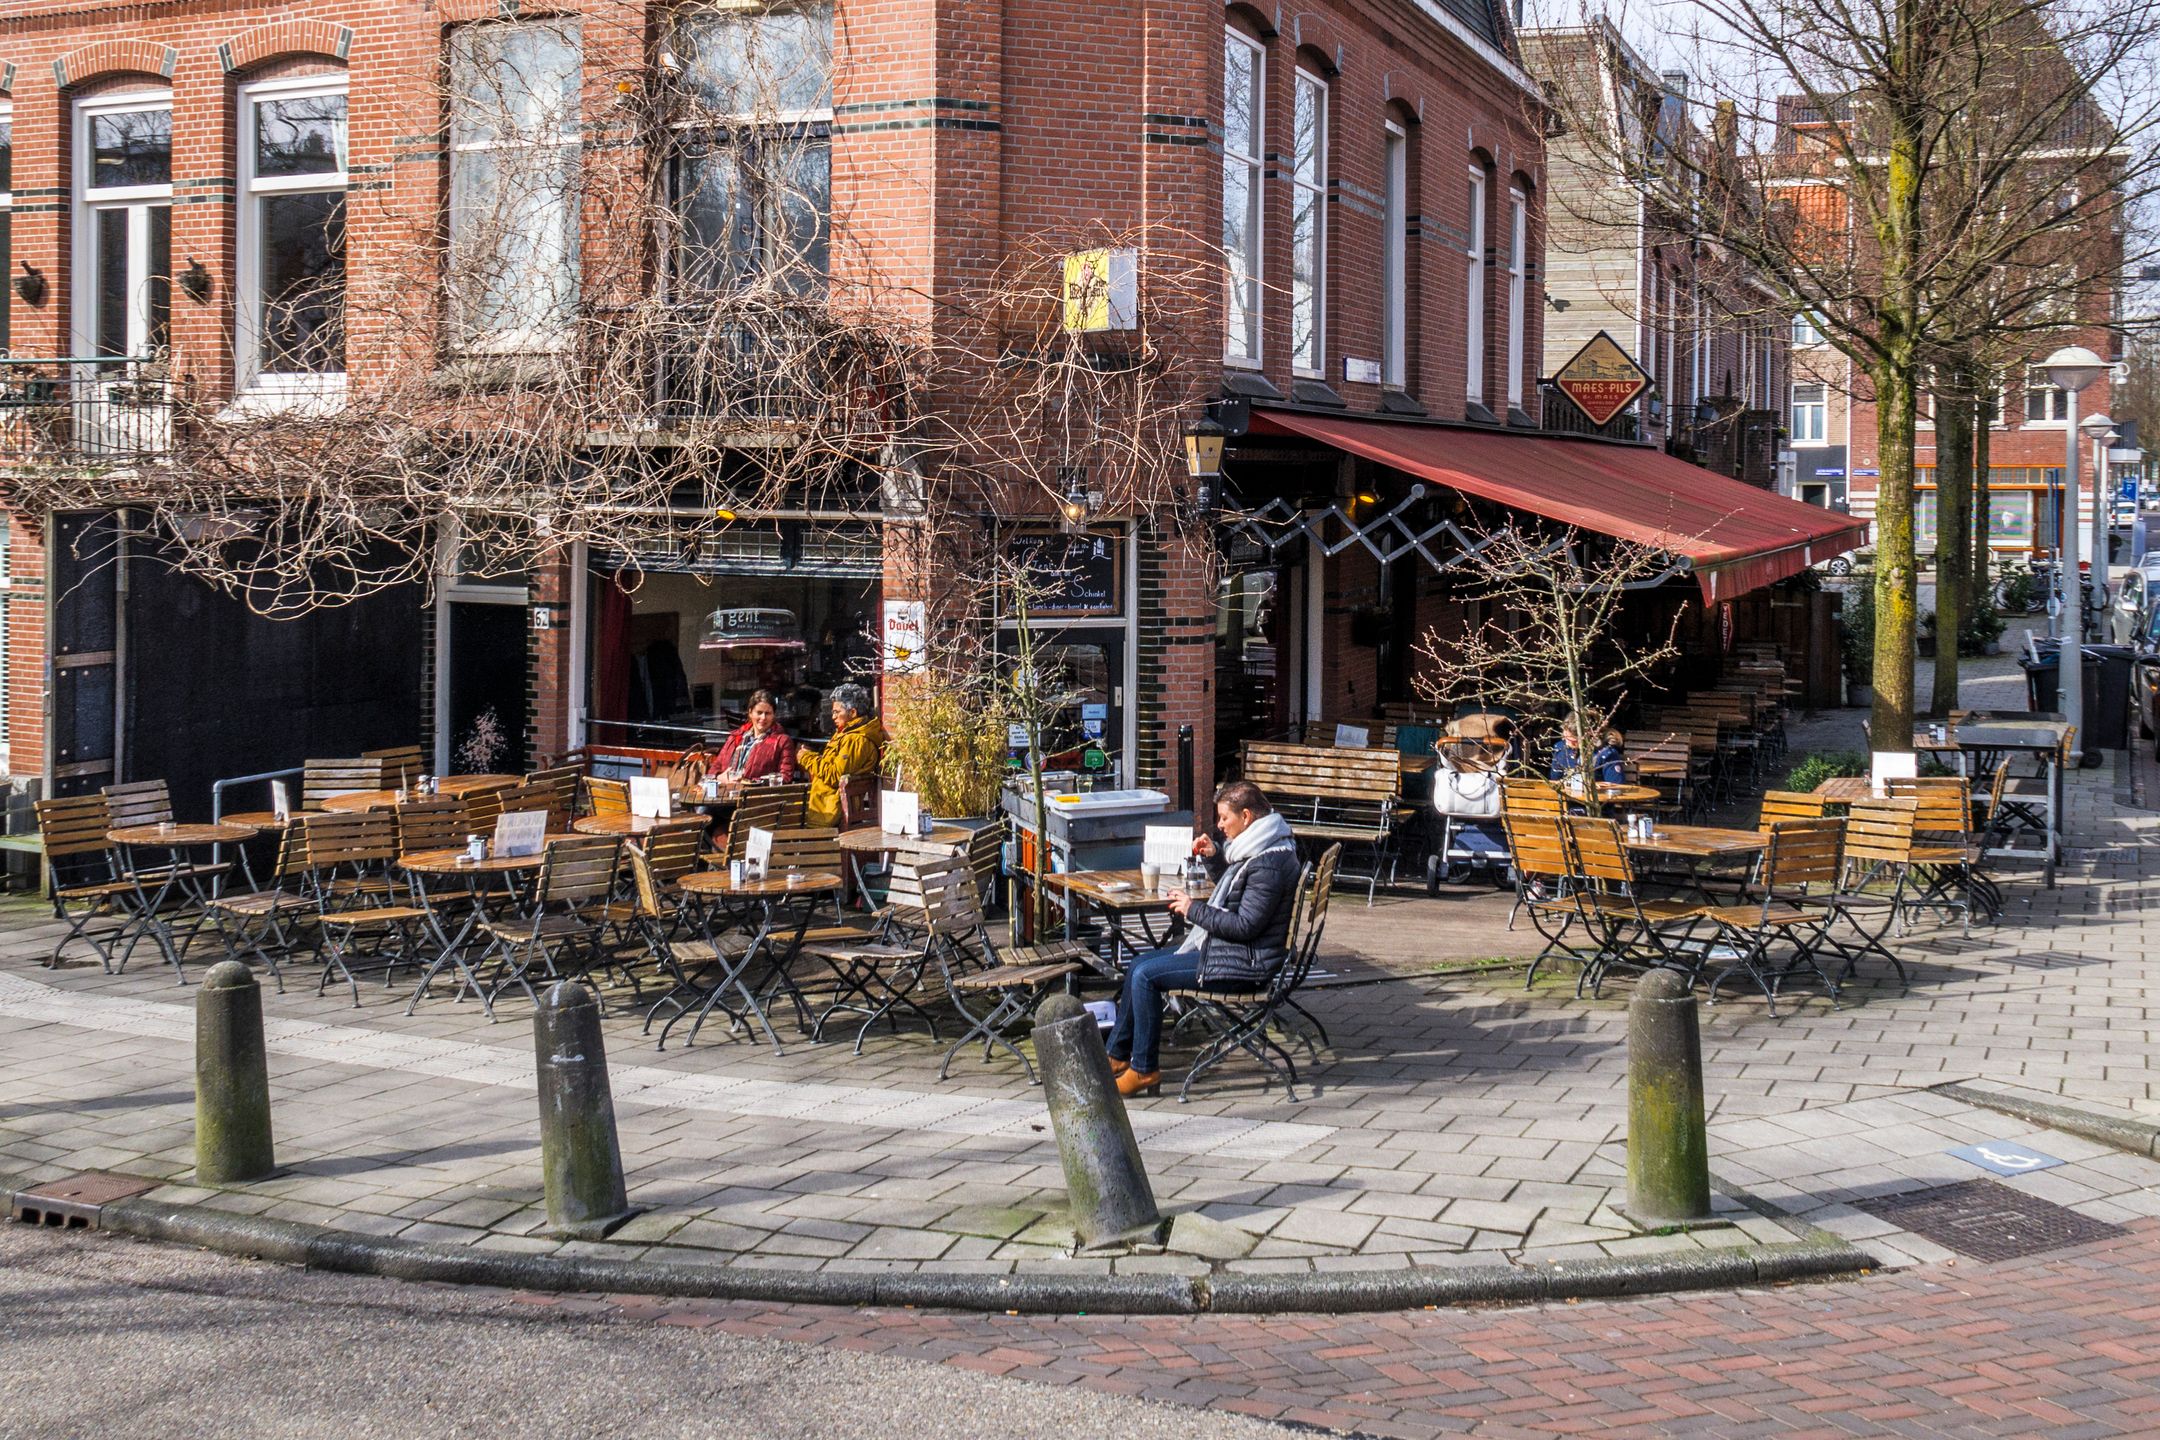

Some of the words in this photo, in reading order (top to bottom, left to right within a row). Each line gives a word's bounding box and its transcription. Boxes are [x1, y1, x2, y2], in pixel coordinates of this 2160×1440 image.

[1071, 575, 1106, 598] Schinkel
[535, 611, 548, 627] 62
[728, 609, 759, 627] gent
[888, 618, 918, 632] Duvel
